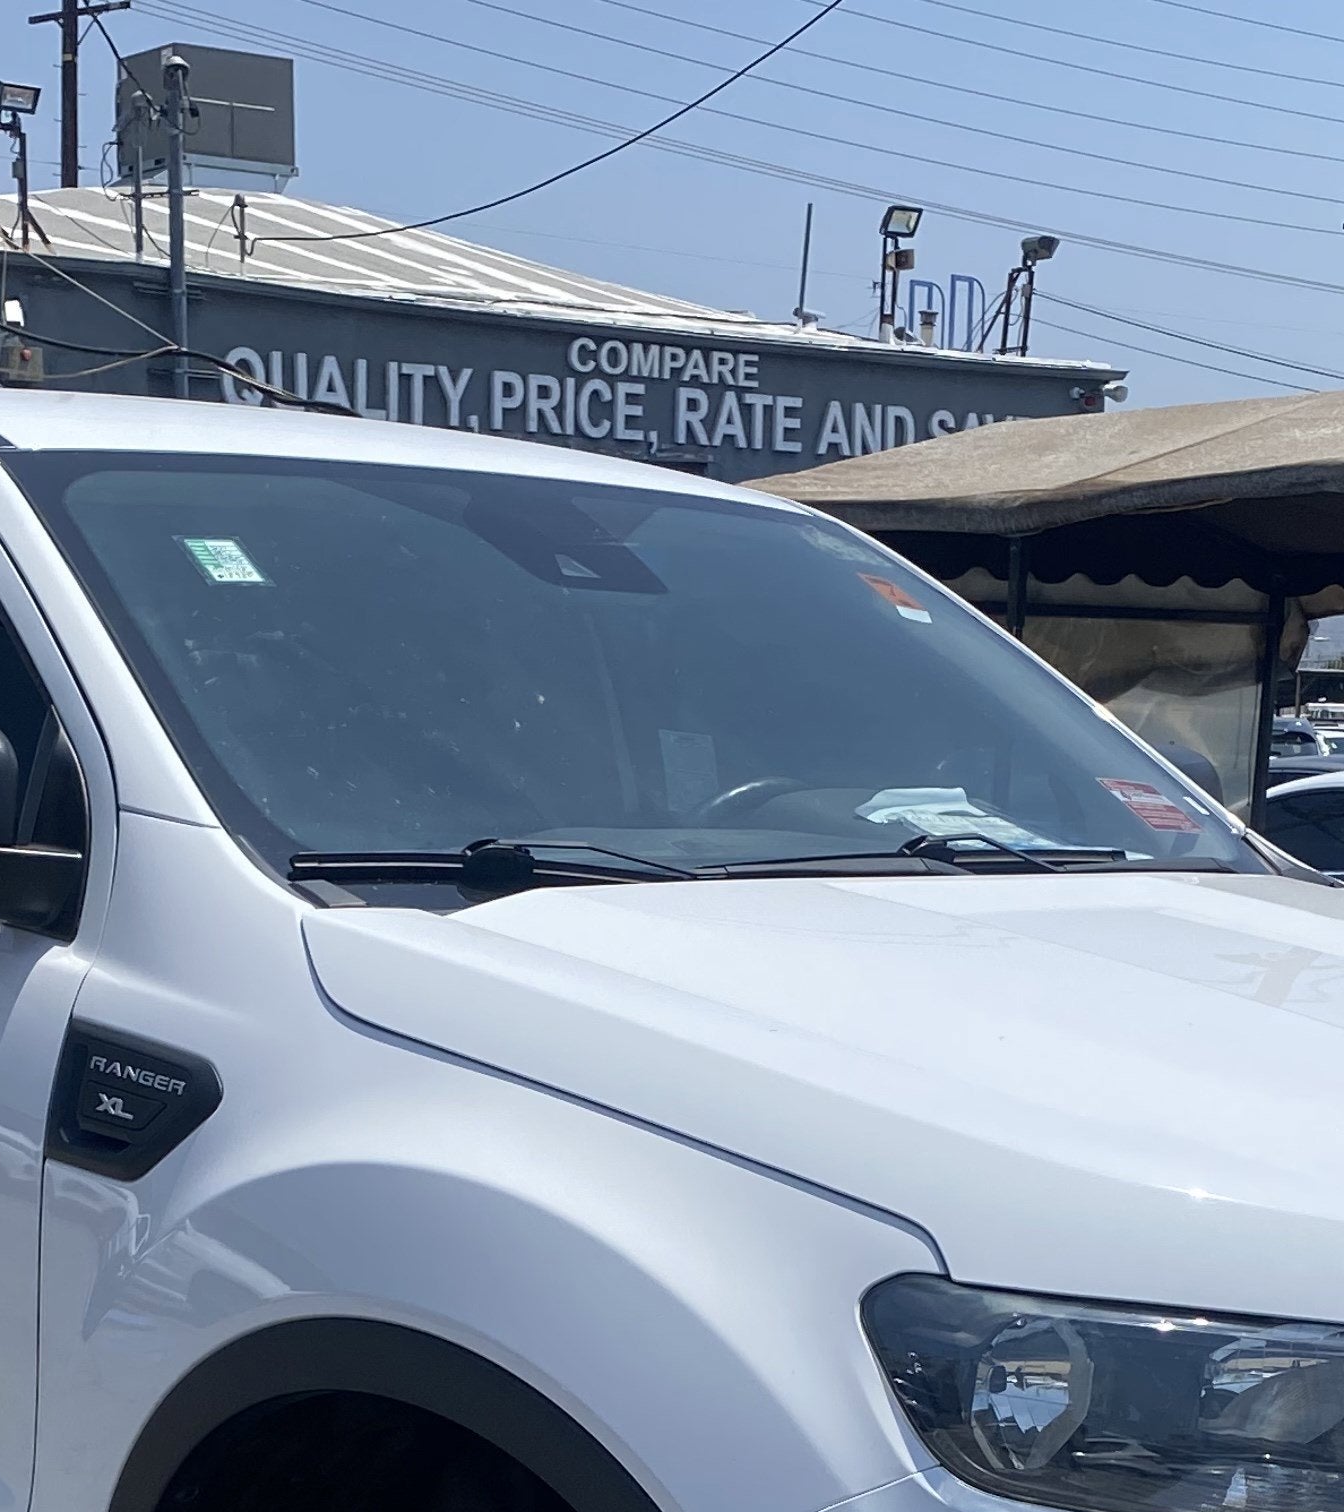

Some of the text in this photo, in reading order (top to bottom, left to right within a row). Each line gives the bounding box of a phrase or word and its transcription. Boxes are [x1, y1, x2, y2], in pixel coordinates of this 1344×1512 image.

[567, 337, 759, 388] COMPARE
[490, 370, 659, 454] PRICE,
[674, 387, 804, 452] RATE
[816, 400, 916, 456] AND
[89, 1056, 187, 1096] RANGER
[95, 1093, 134, 1120] XL
